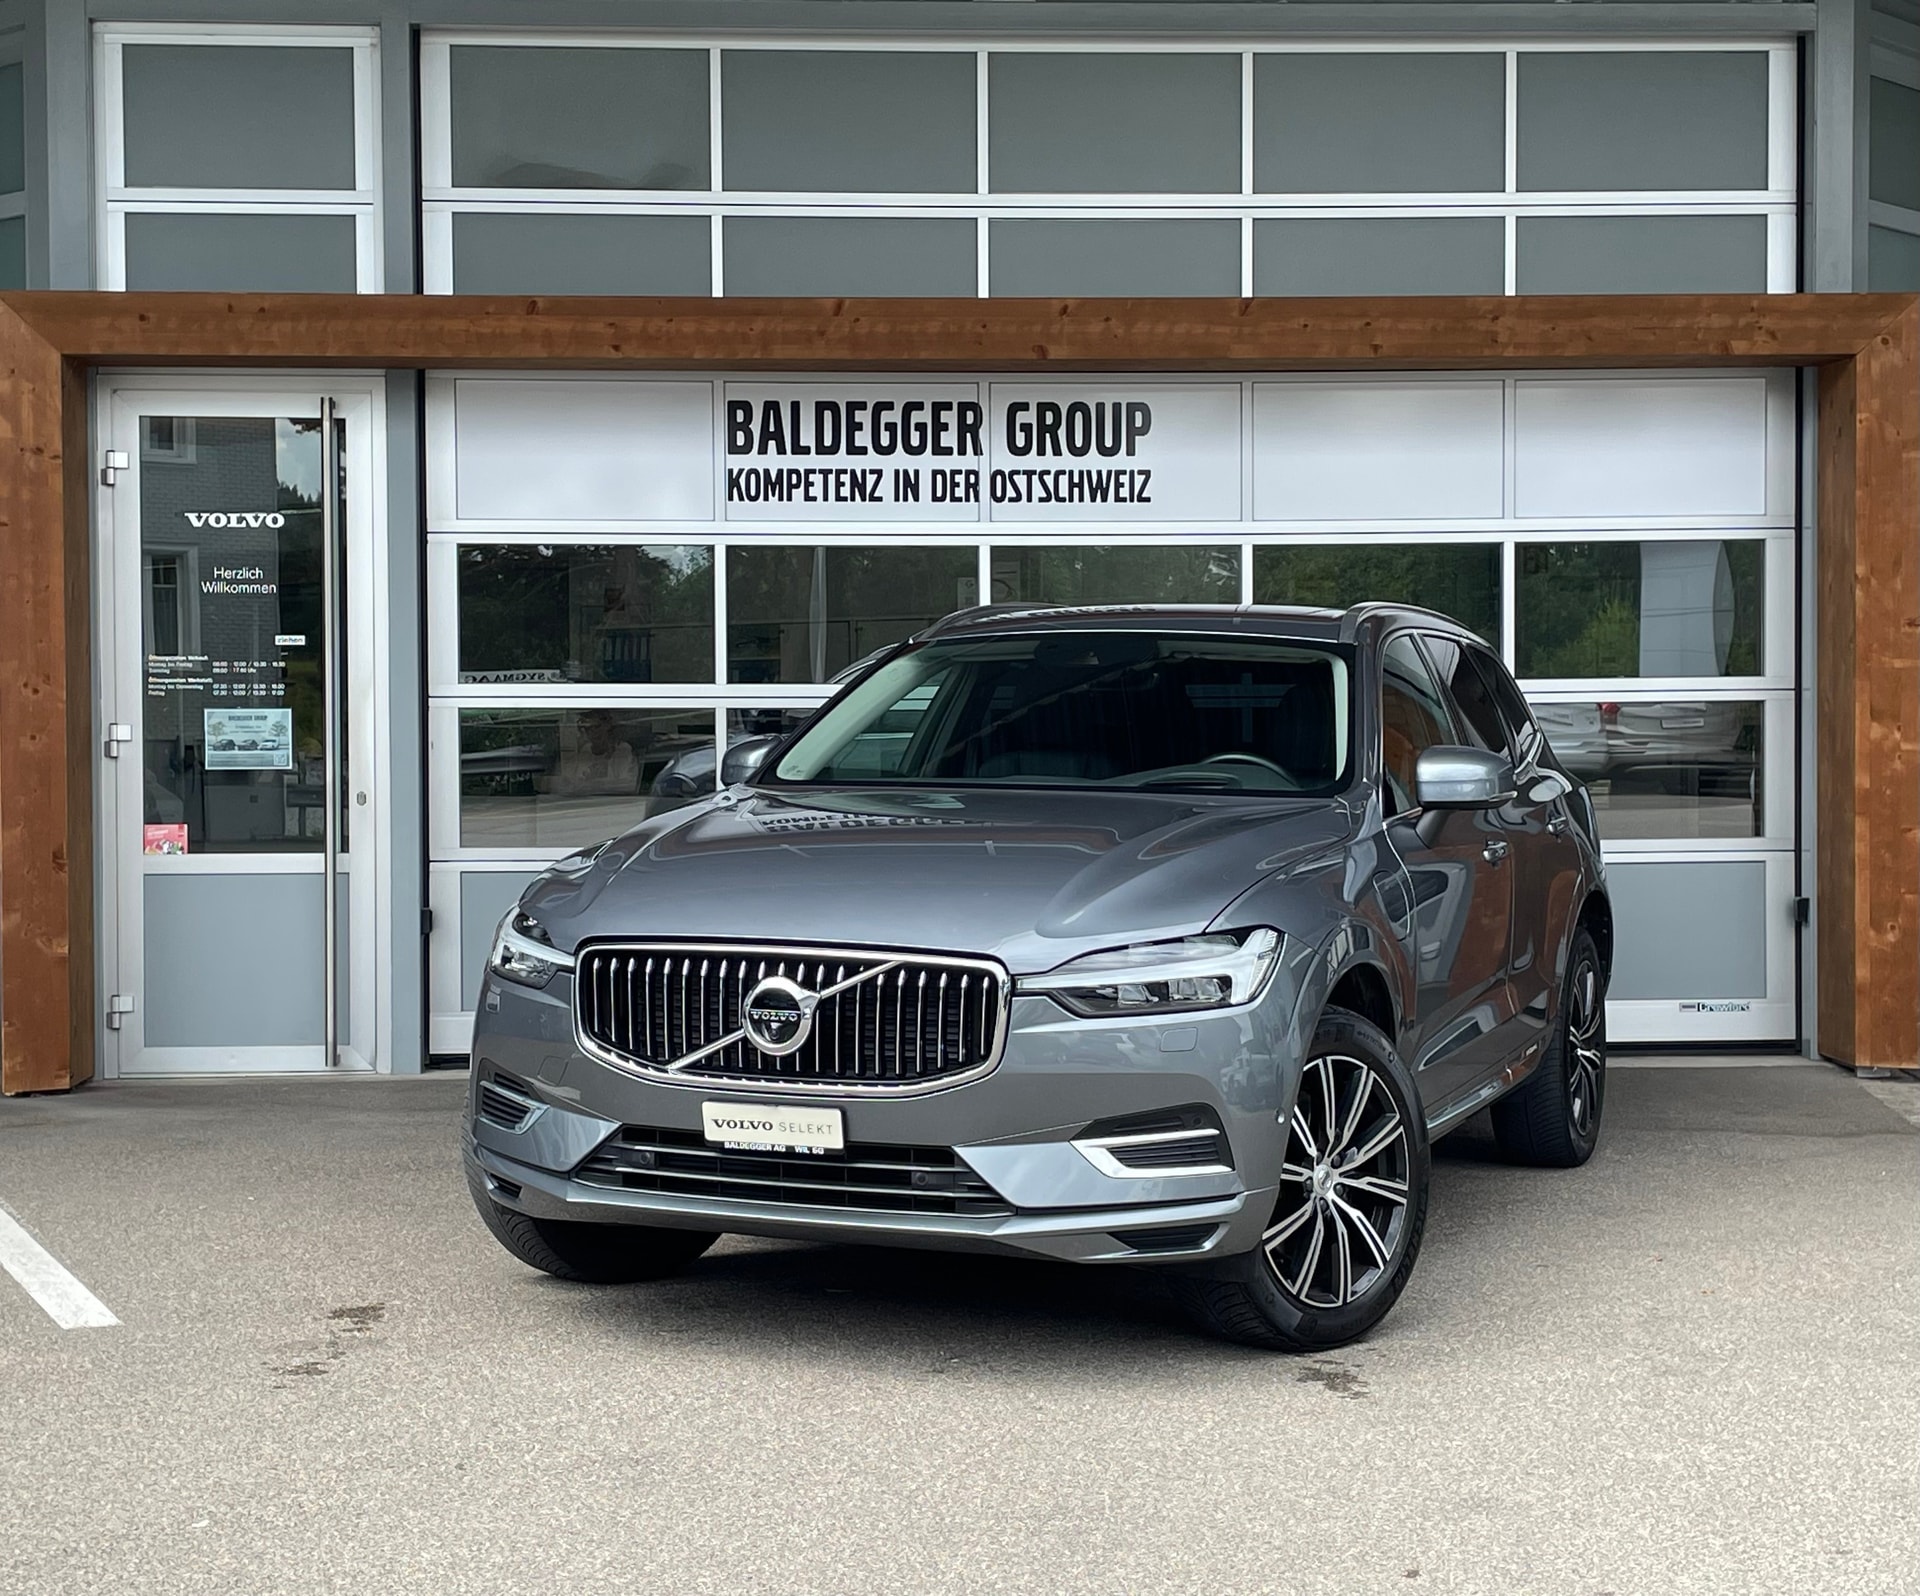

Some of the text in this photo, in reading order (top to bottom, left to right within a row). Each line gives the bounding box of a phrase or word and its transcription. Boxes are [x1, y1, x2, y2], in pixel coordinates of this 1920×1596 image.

[726, 400, 1152, 458] BALDEGGER GROUP
[727, 468, 1152, 504] KOMPETENZ IN DER OSTSCHWEIZ
[184, 512, 285, 529] VOLVO
[213, 566, 264, 580] Herzlich
[200, 580, 277, 594] Willkommen
[750, 1011, 798, 1022] VOLVO
[711, 1118, 834, 1135] VOLVO SELEKT
[723, 1141, 773, 1152] BALDEGGER
[773, 1143, 787, 1152] AG
[794, 1145, 810, 1154] WIL
